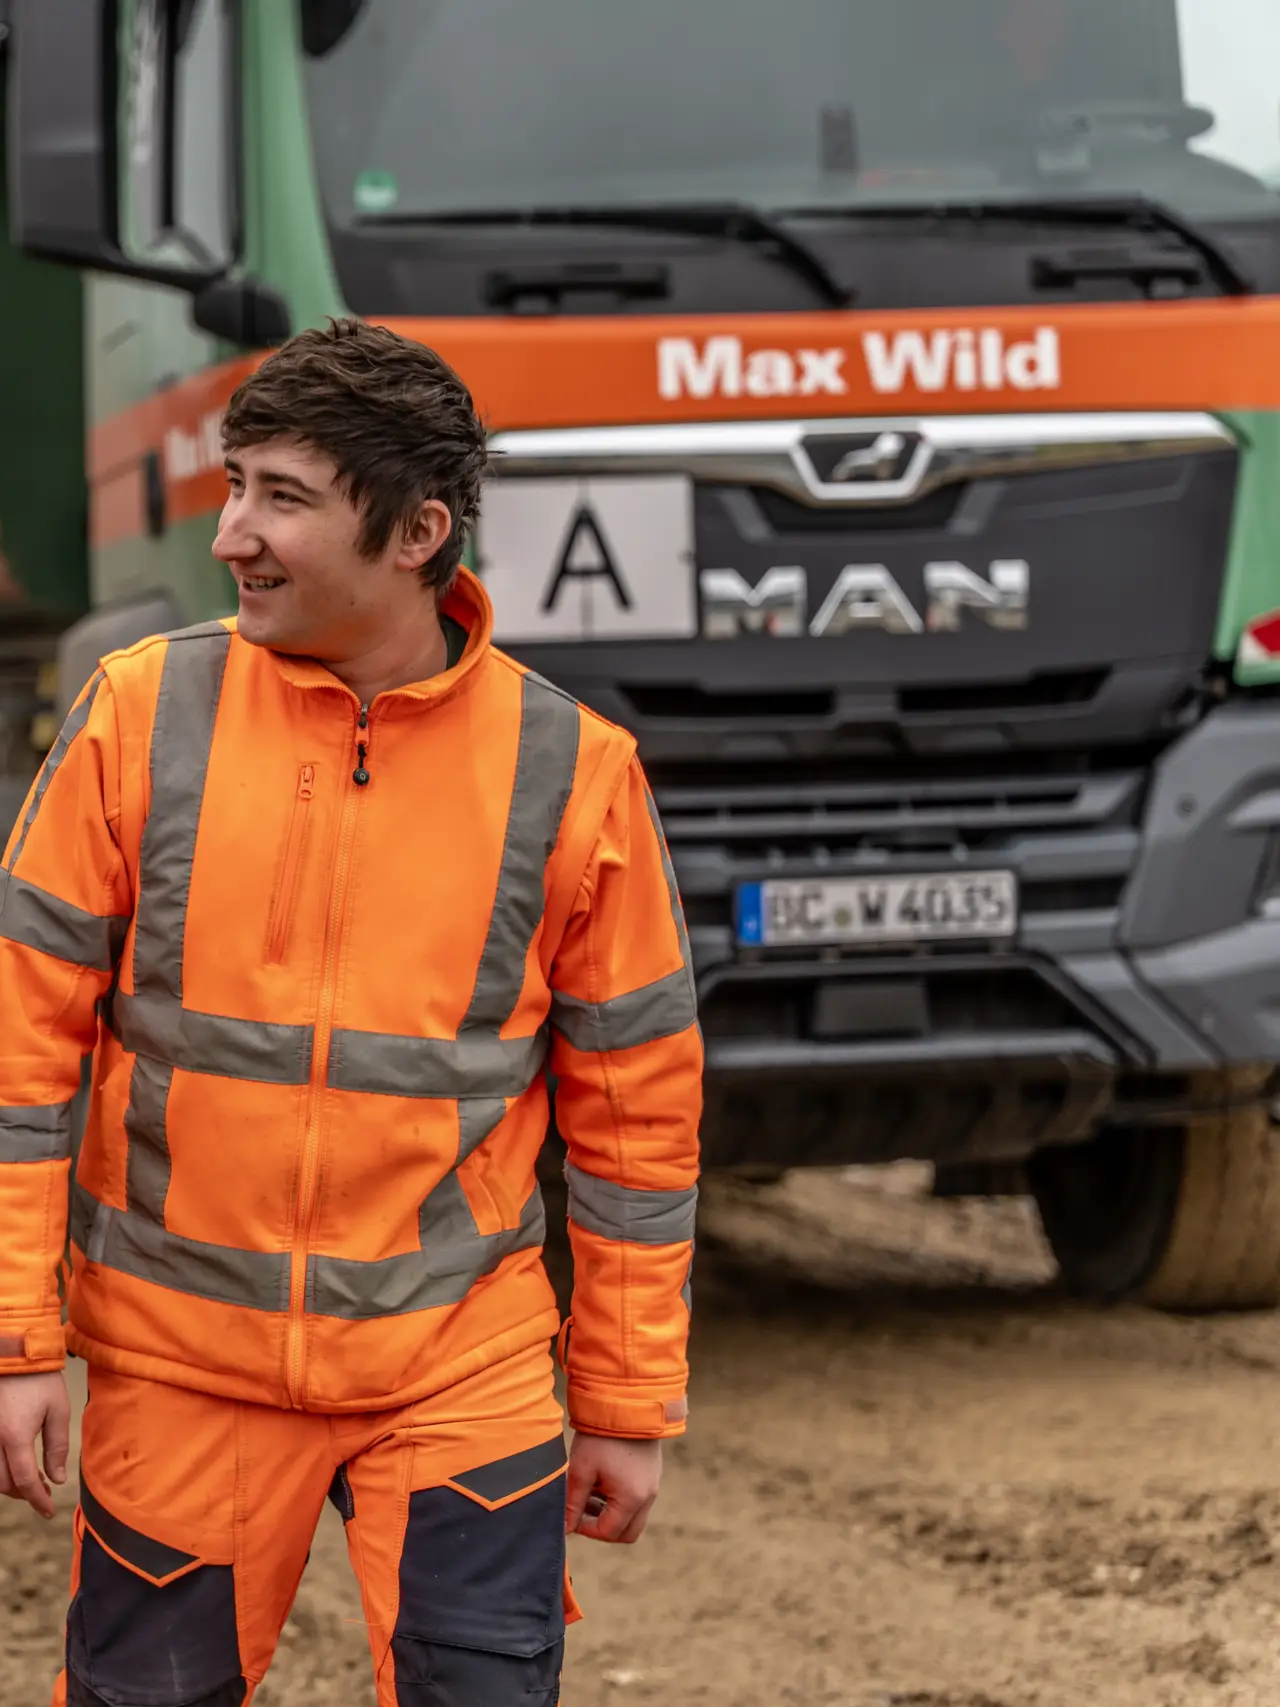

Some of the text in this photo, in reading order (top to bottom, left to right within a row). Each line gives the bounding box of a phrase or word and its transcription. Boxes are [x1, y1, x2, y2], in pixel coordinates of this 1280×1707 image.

[657, 326, 1060, 398] Max Wild
[542, 503, 632, 613] A
[700, 559, 1030, 638] MAN
